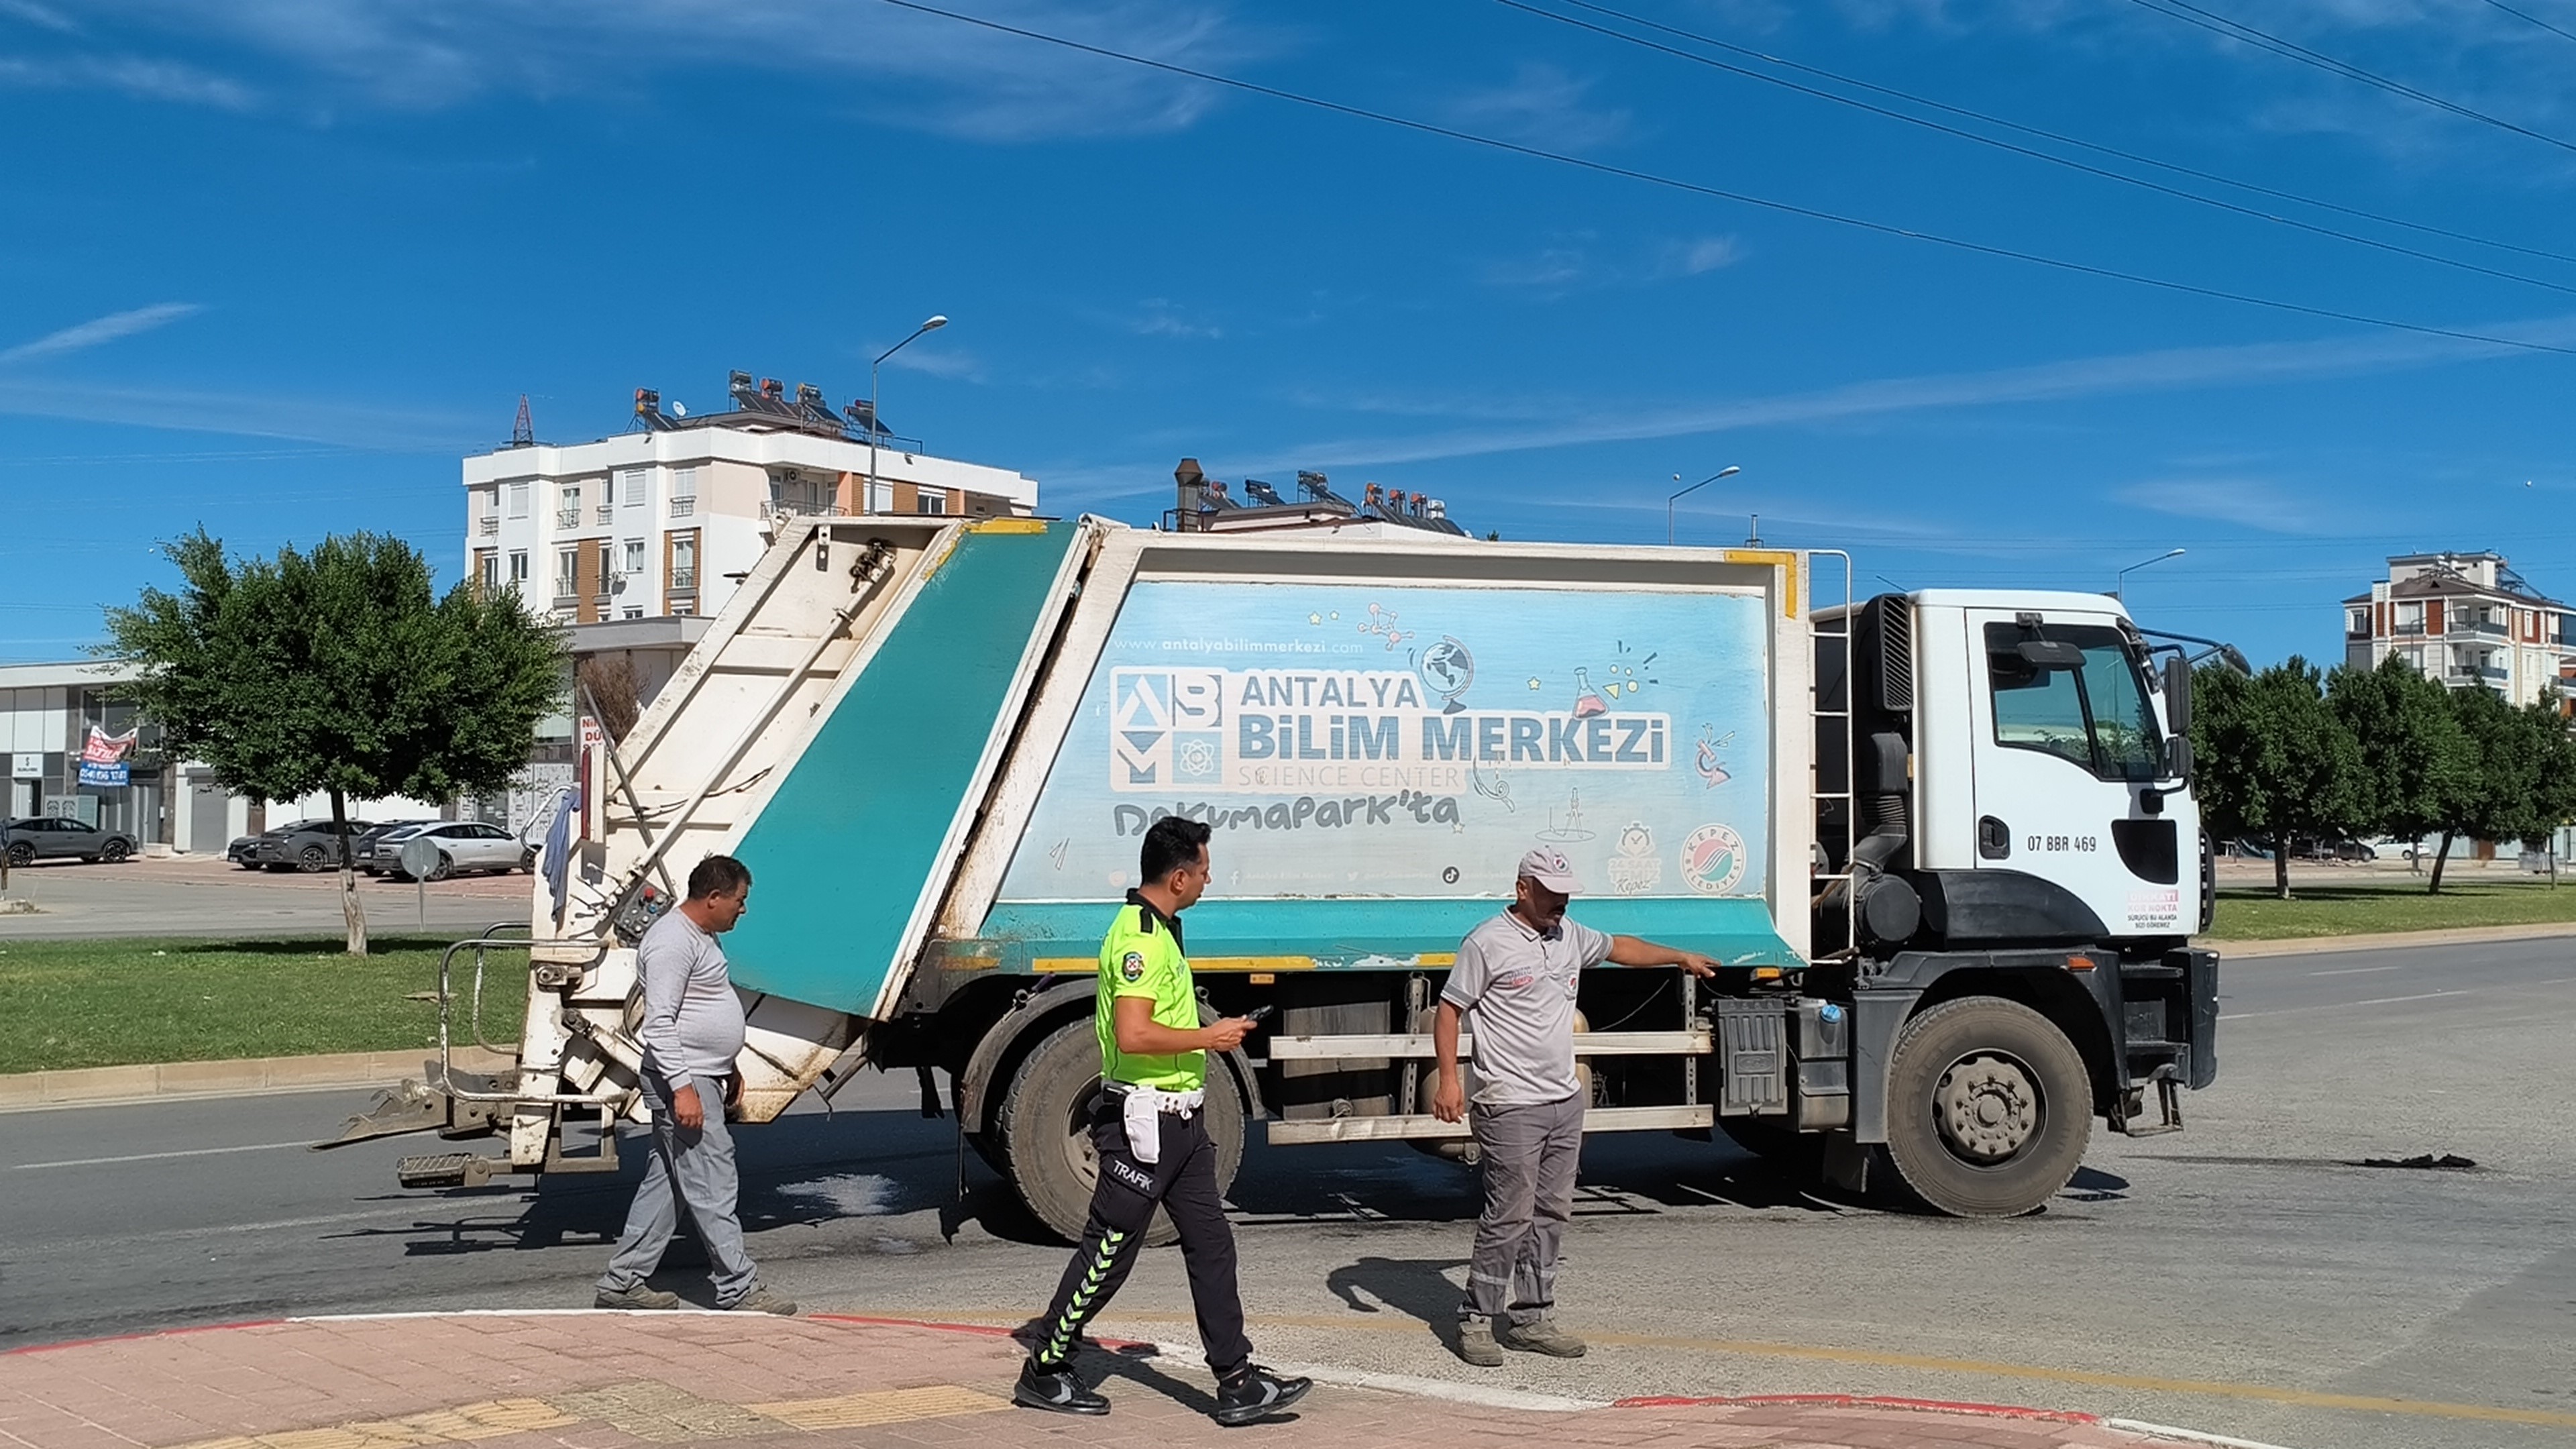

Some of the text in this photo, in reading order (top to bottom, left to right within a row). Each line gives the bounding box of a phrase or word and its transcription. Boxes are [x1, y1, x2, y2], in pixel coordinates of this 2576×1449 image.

[1240, 676, 1419, 708] ANTALYA
[1238, 765, 1460, 788] SCIENCE CENTER
[1688, 828, 1739, 851] KEPEZ
[2027, 835, 2096, 852] 07 BBR 469
[1616, 879, 1650, 896] Kepez
[2149, 904, 2177, 912] NOKTA
